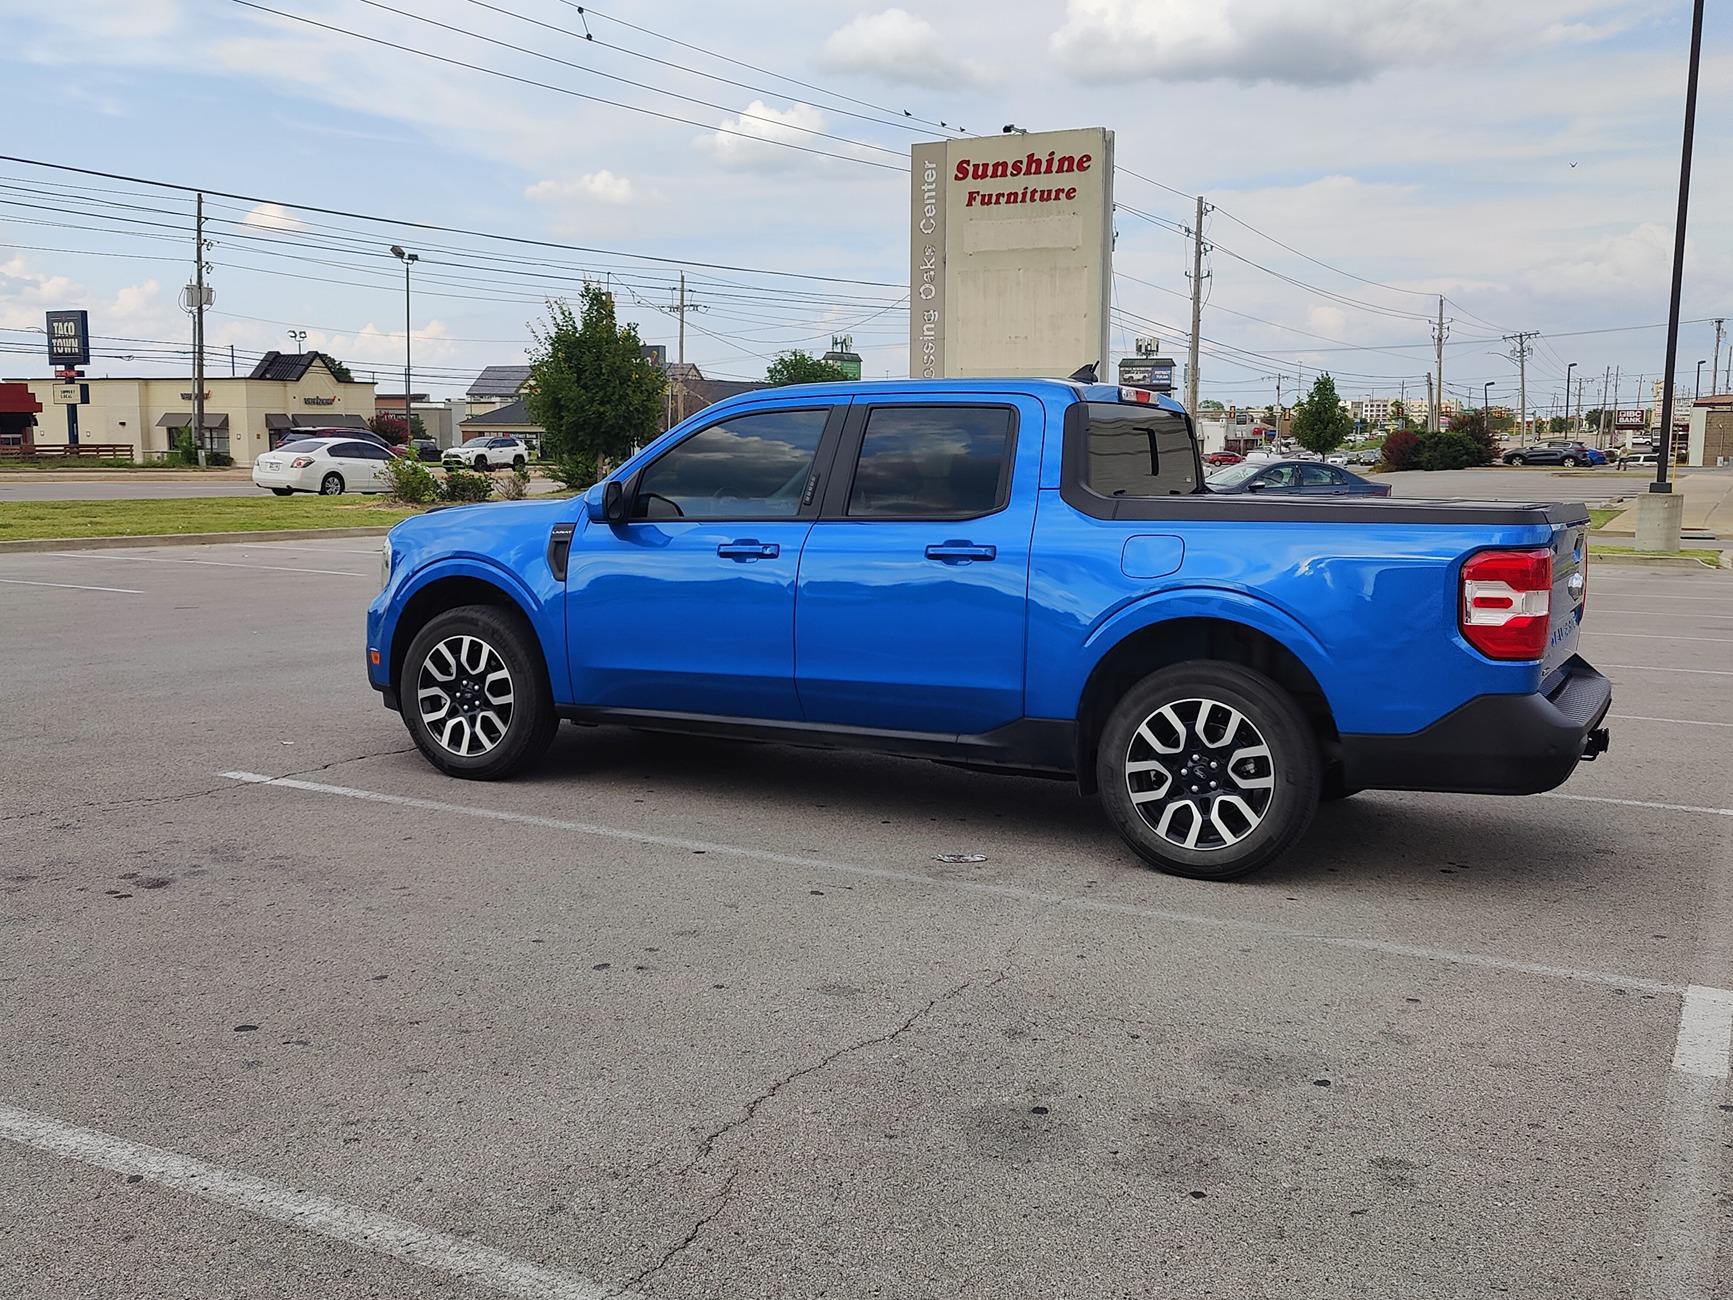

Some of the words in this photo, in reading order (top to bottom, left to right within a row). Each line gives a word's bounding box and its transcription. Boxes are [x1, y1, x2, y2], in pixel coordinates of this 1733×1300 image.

[954, 151, 1092, 182] Sunshine
[919, 160, 937, 234] Center
[965, 186, 1078, 207] Furniture
[919, 244, 936, 300] Oaks
[52, 321, 75, 337] TACO
[52, 338, 79, 353] TOWN
[304, 396, 335, 406] verizon
